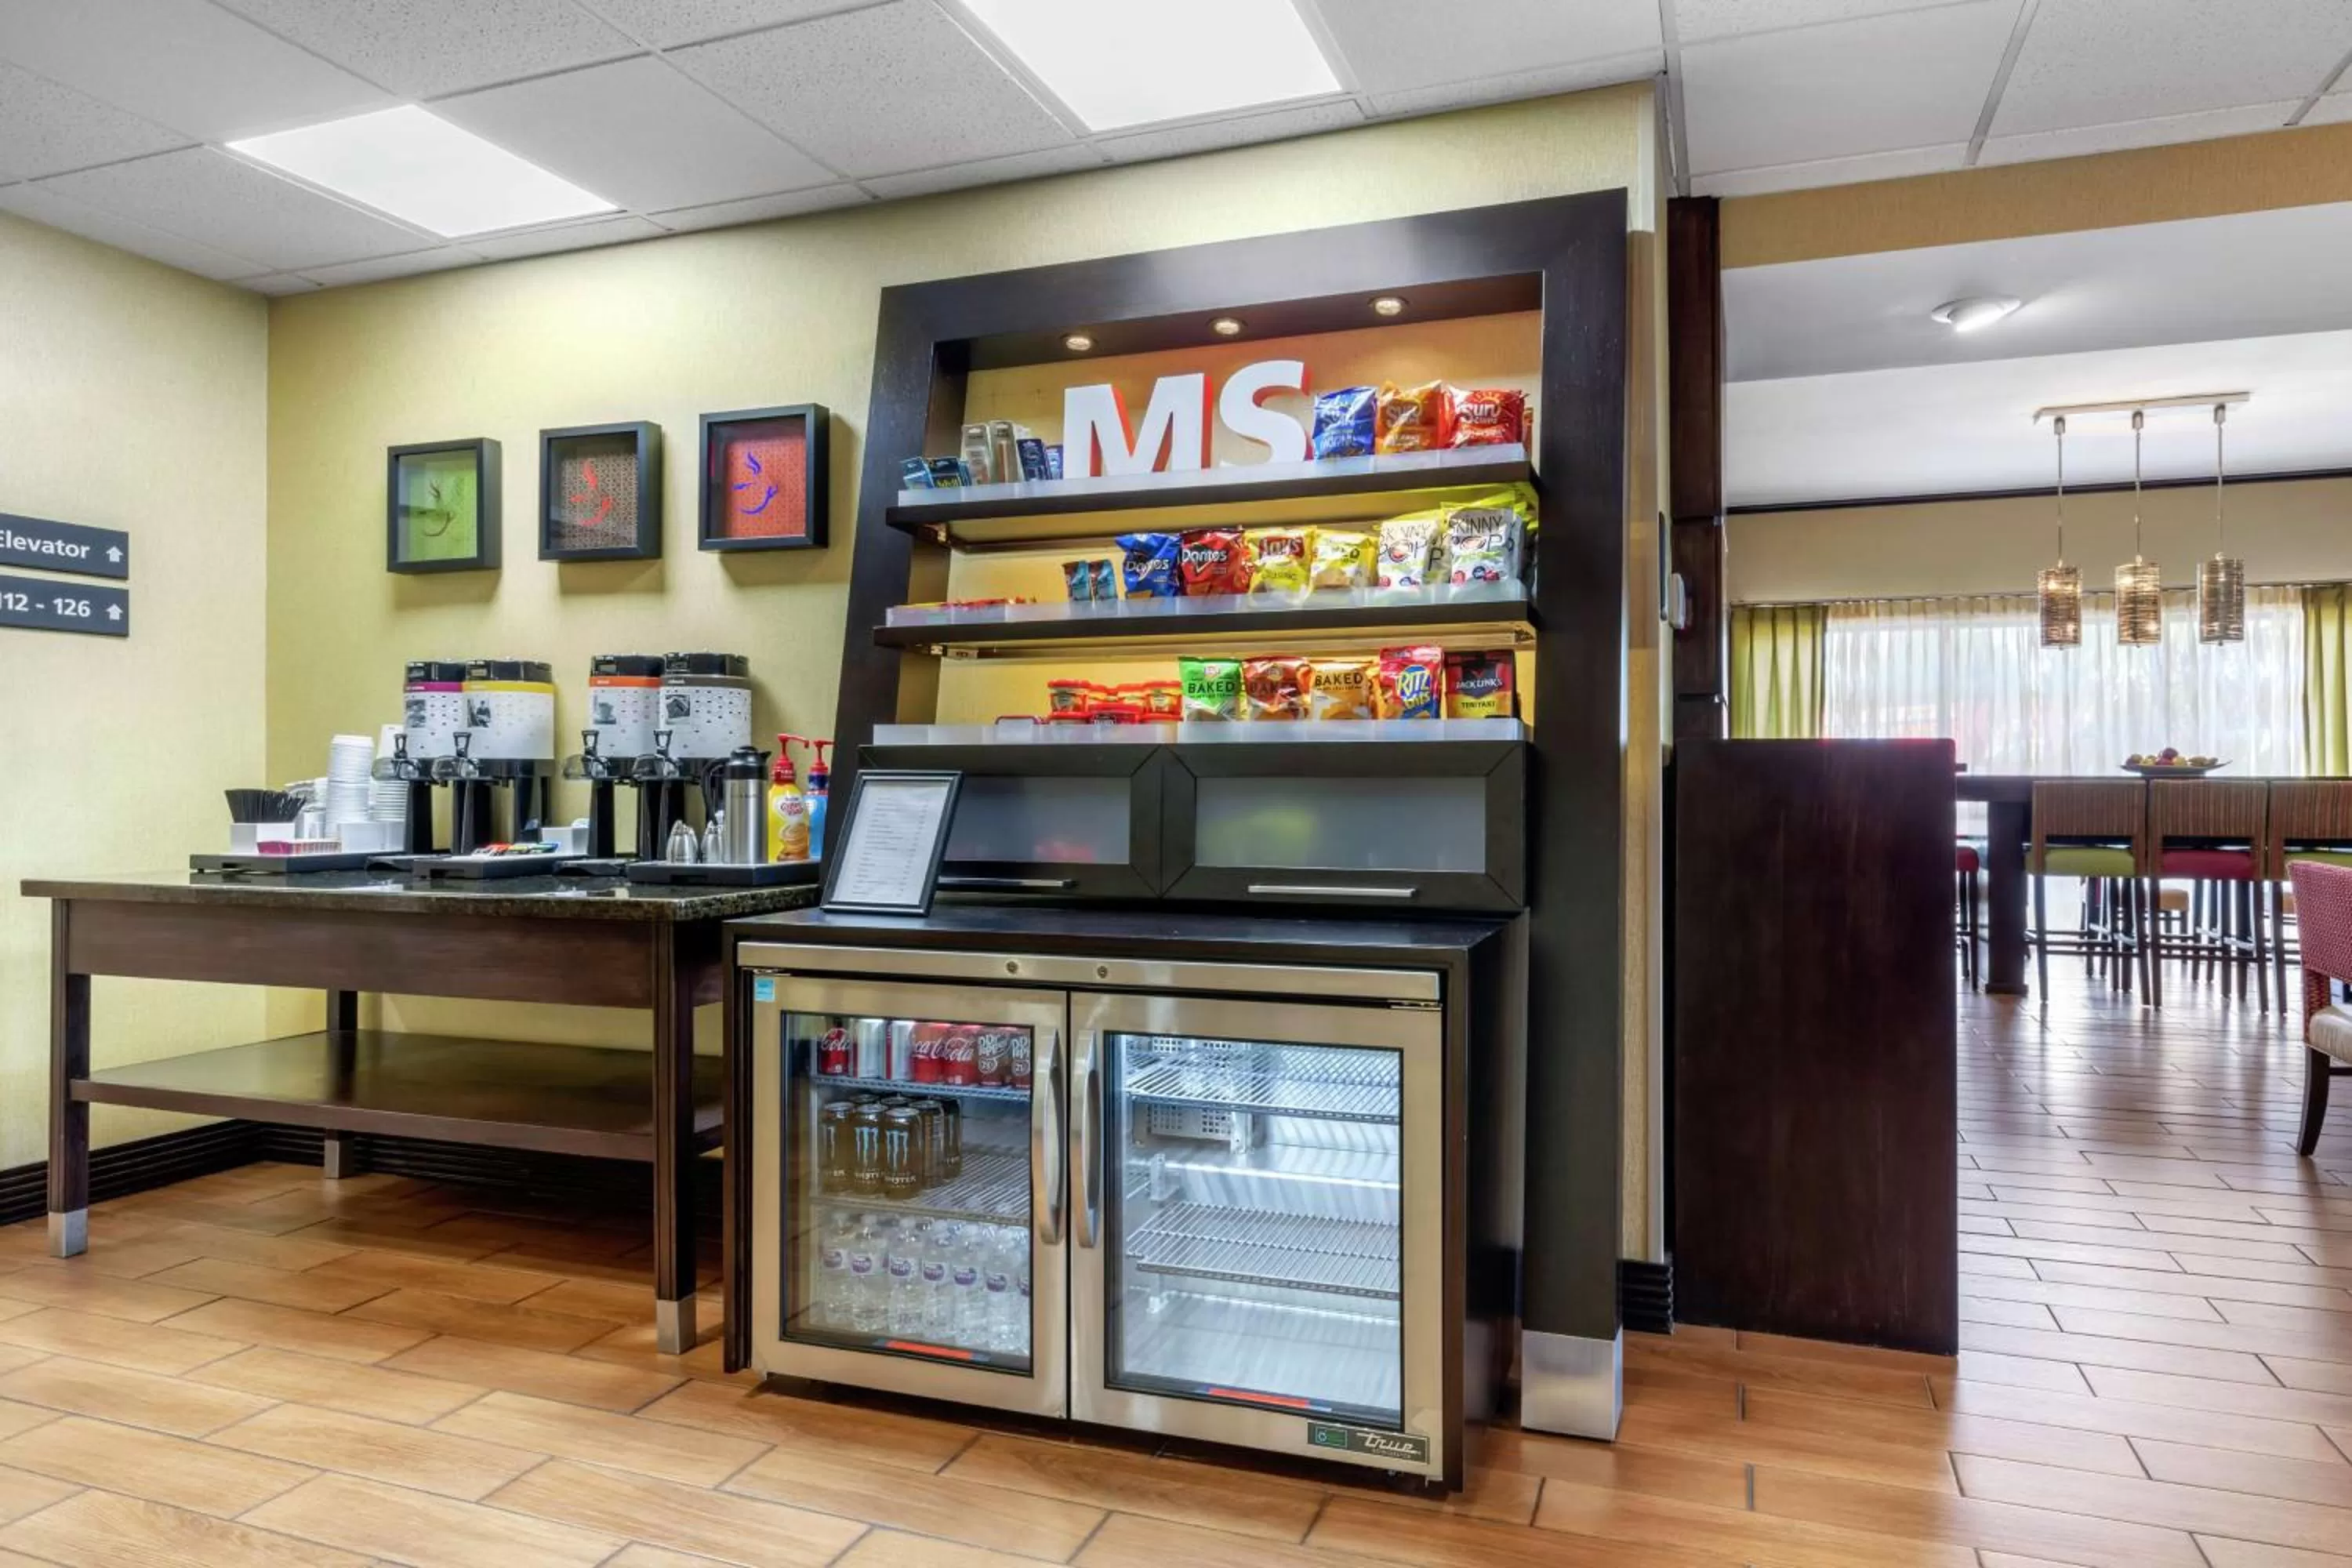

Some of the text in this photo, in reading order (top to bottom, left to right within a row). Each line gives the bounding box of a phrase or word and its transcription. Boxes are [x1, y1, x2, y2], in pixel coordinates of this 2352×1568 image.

[1381, 522, 1431, 542] SKNNY
[1450, 515, 1503, 534] SKINNY
[1182, 548, 1227, 564] Doritos
[1127, 557, 1169, 573] Doos
[53, 597, 91, 617] 126
[1188, 681, 1236, 694] BAKED
[1315, 672, 1363, 687] BAKED
[1399, 672, 1430, 698] RITZ
